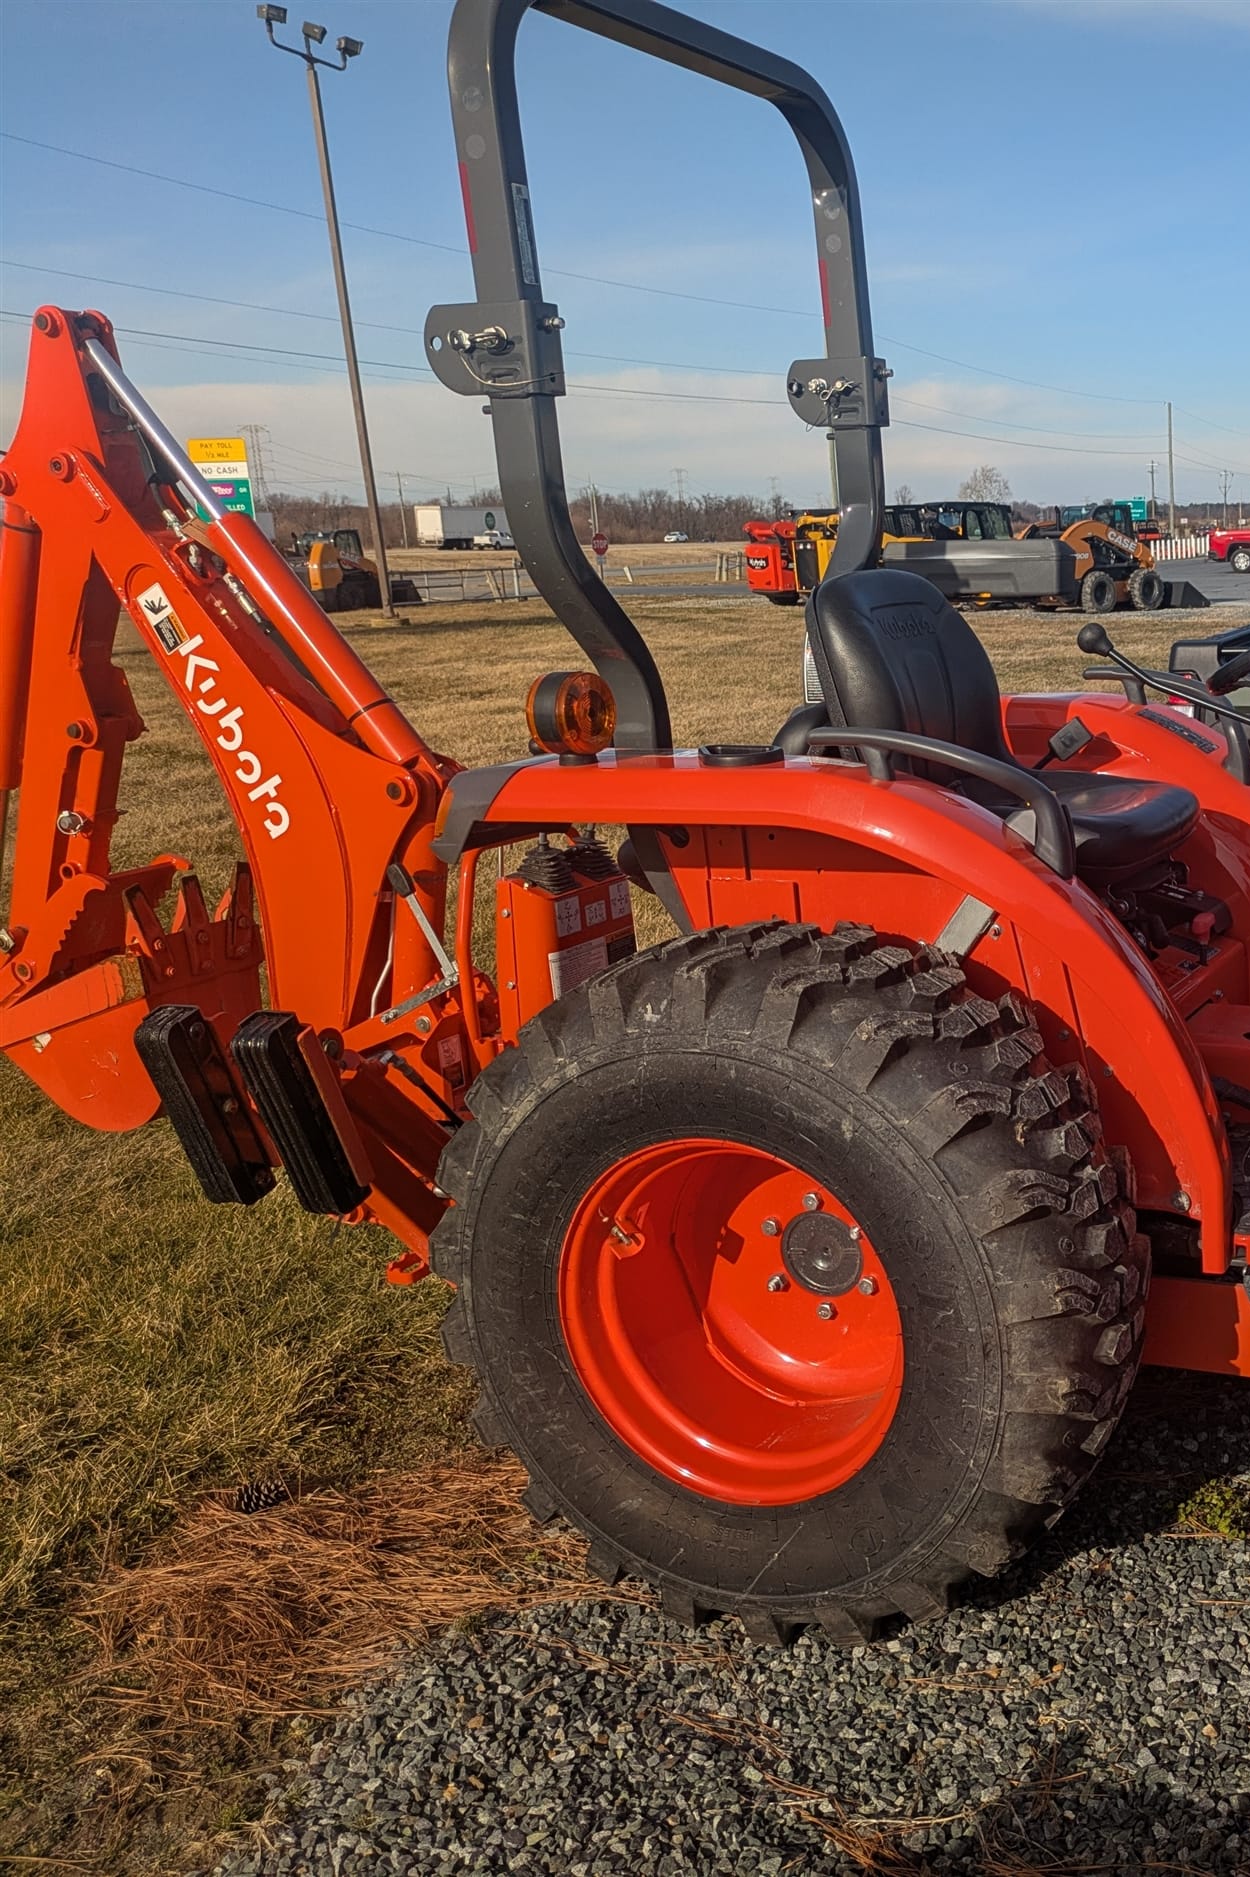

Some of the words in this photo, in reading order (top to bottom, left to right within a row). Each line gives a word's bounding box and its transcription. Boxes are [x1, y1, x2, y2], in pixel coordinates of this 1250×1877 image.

[592, 540, 608, 549] STOP
[1107, 530, 1138, 553] CASE
[177, 633, 290, 840] Kubota
